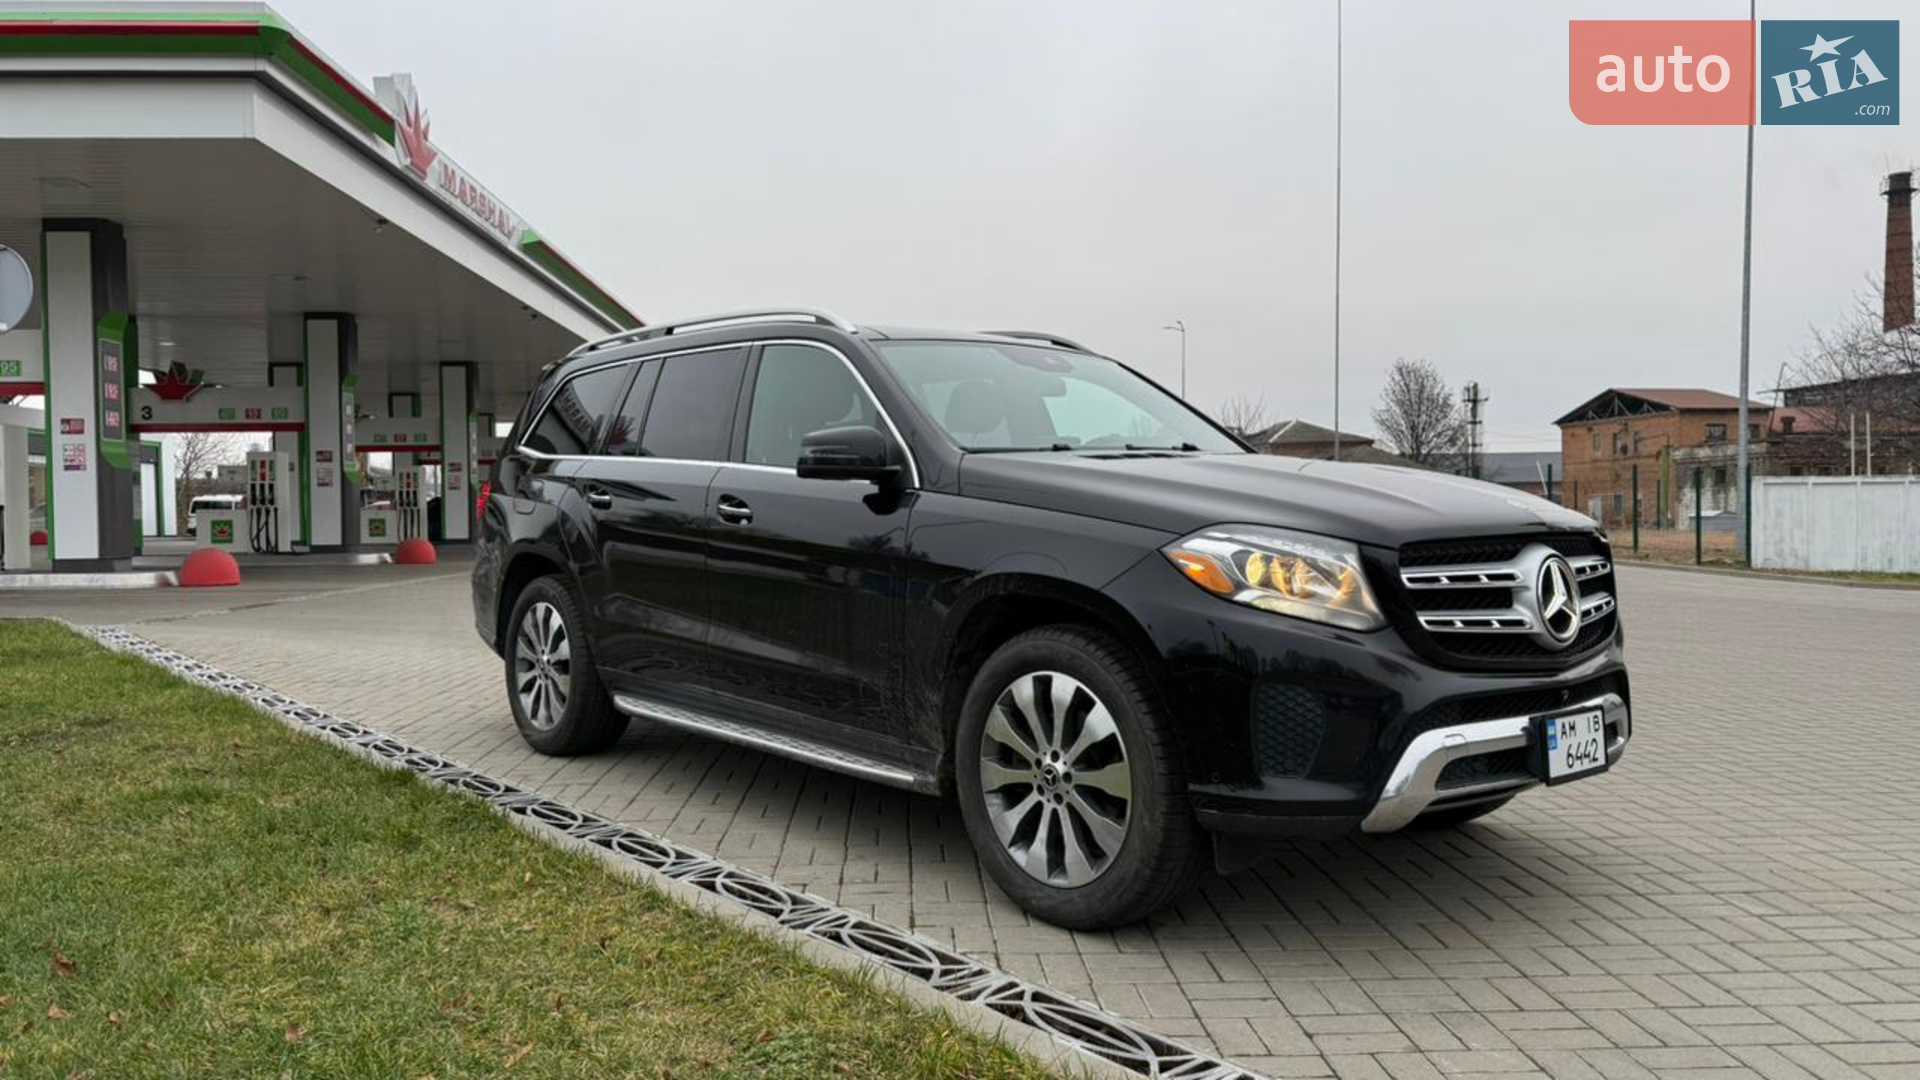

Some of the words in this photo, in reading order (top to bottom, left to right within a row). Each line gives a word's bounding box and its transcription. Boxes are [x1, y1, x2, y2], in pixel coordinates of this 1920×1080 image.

[141, 406, 153, 420] 3
[1561, 720, 1577, 740] AM
[1566, 738, 1599, 768] 6442
